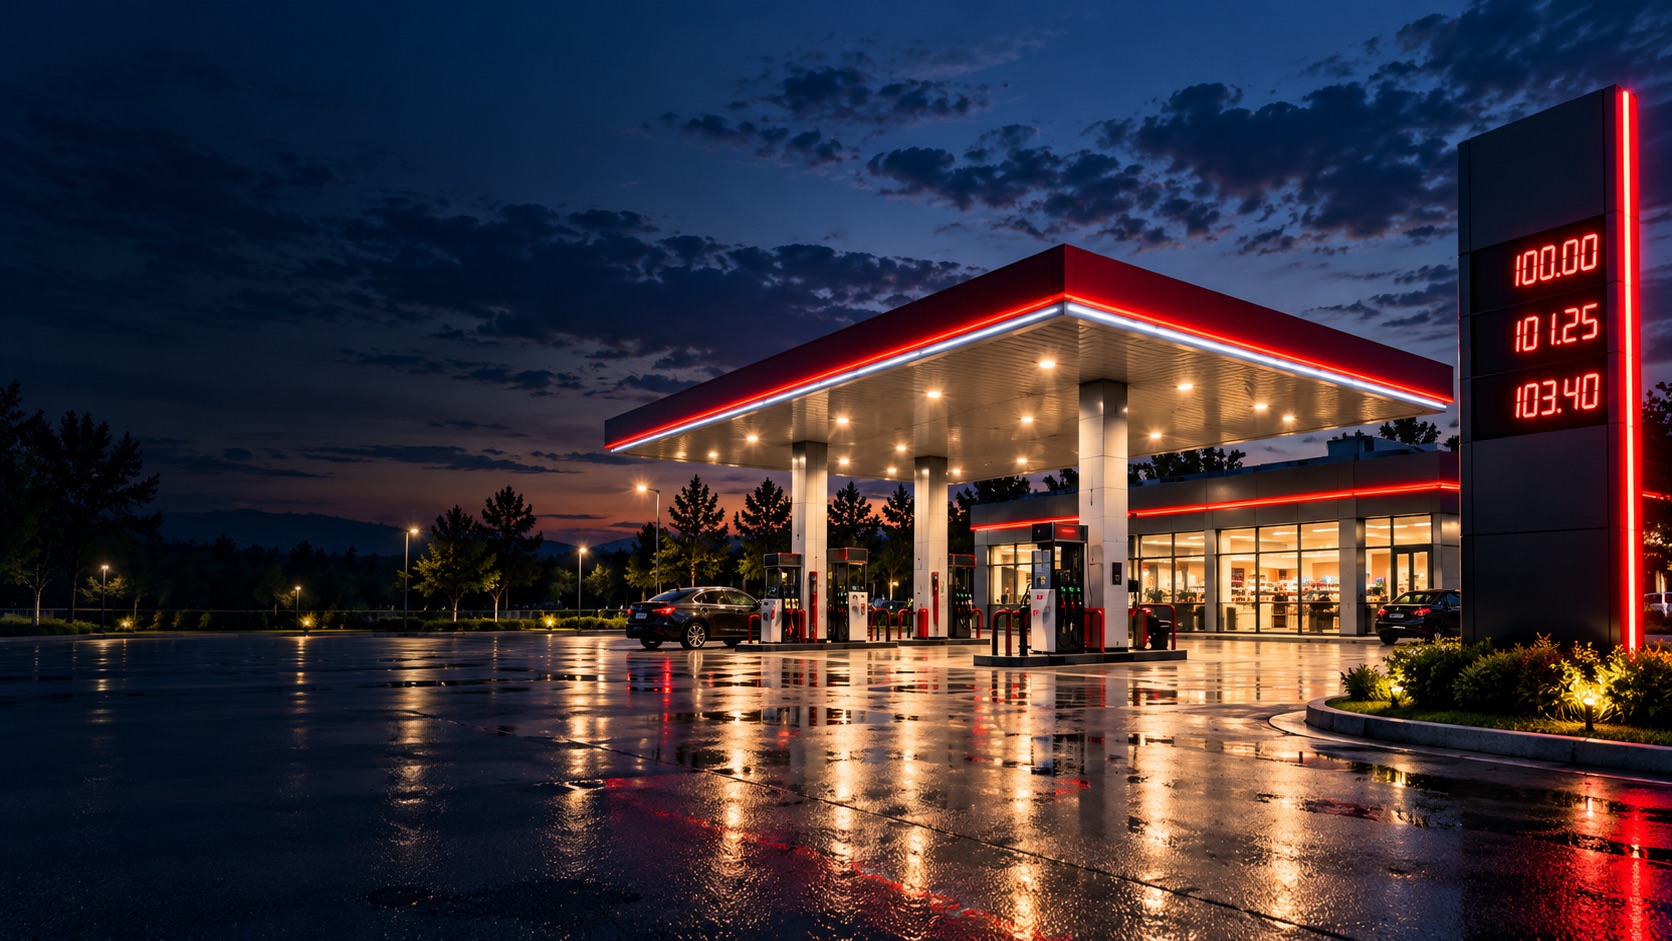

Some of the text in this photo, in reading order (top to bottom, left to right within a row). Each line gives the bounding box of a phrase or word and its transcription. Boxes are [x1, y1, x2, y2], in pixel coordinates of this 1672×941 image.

[1515, 233, 1598, 286] 100.00
[1516, 303, 1598, 352] 101.25
[1516, 372, 1600, 418] 103.40
